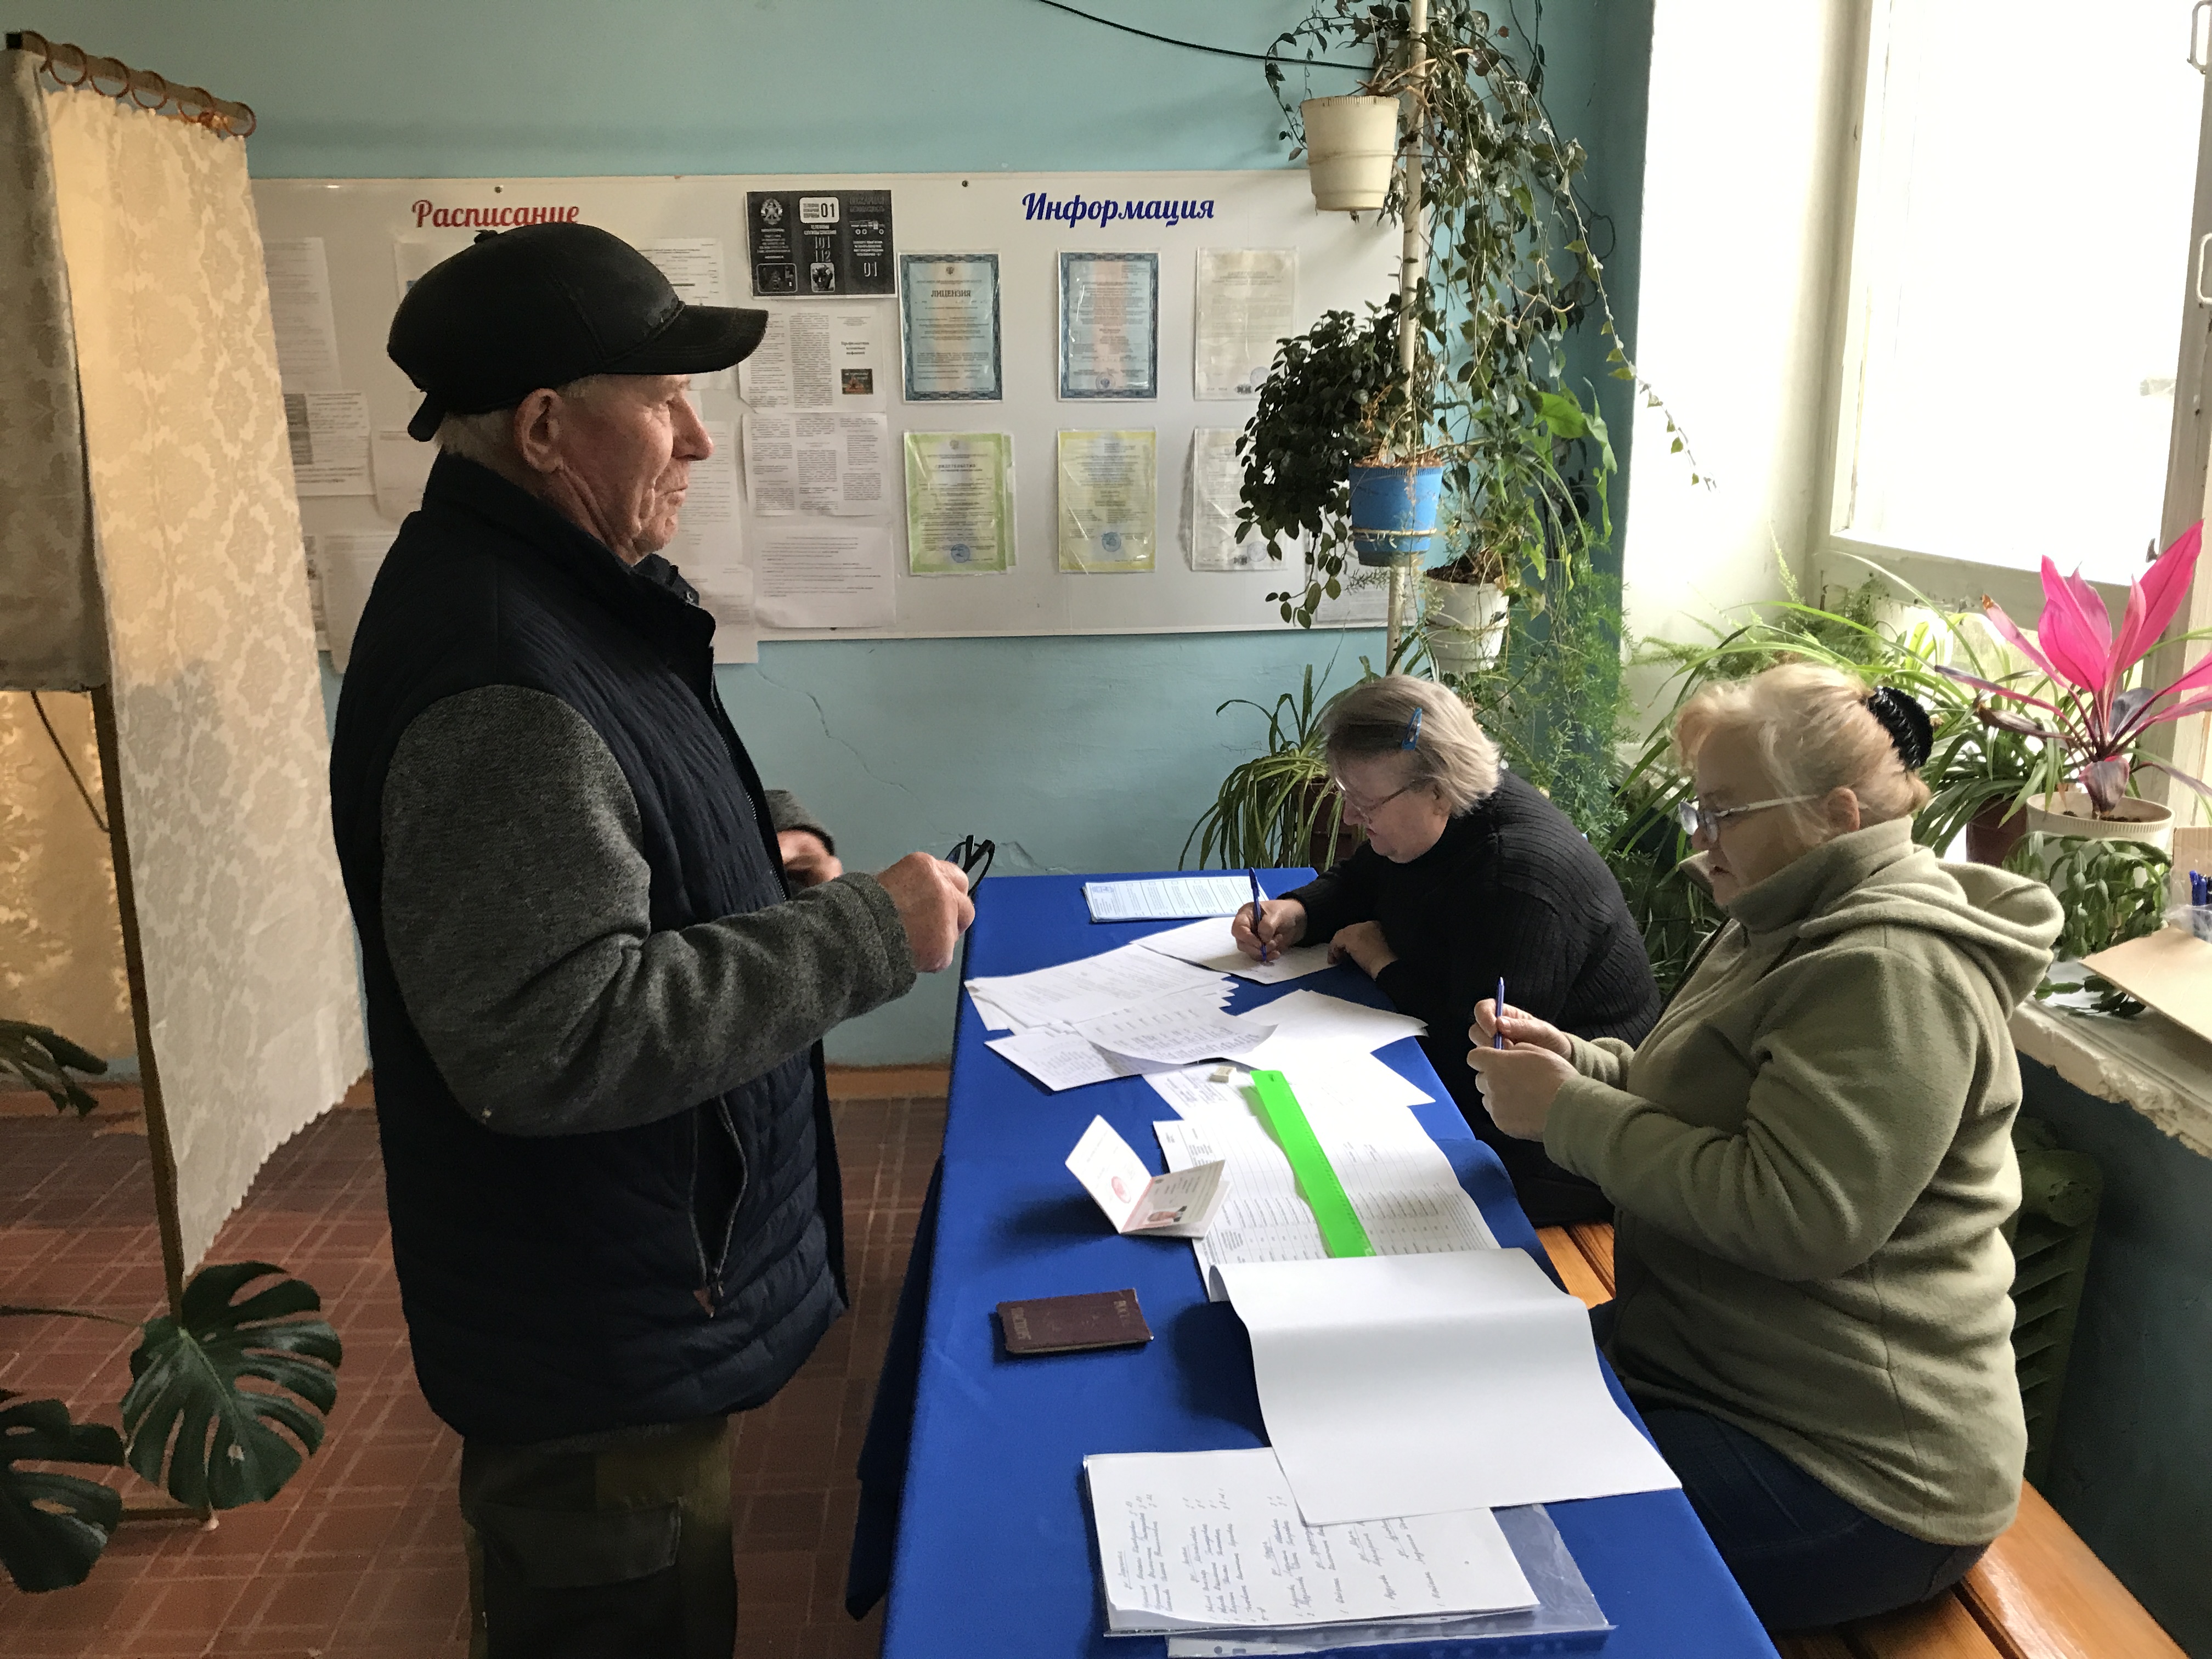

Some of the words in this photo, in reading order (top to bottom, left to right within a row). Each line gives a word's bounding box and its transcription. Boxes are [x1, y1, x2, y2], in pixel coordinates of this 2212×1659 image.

[412, 199, 579, 228] Расписание
[821, 203, 834, 218] 01
[1022, 192, 1215, 228] Информация
[864, 262, 877, 276] 01
[931, 290, 971, 298] ЛИЦЕНЗИЯ
